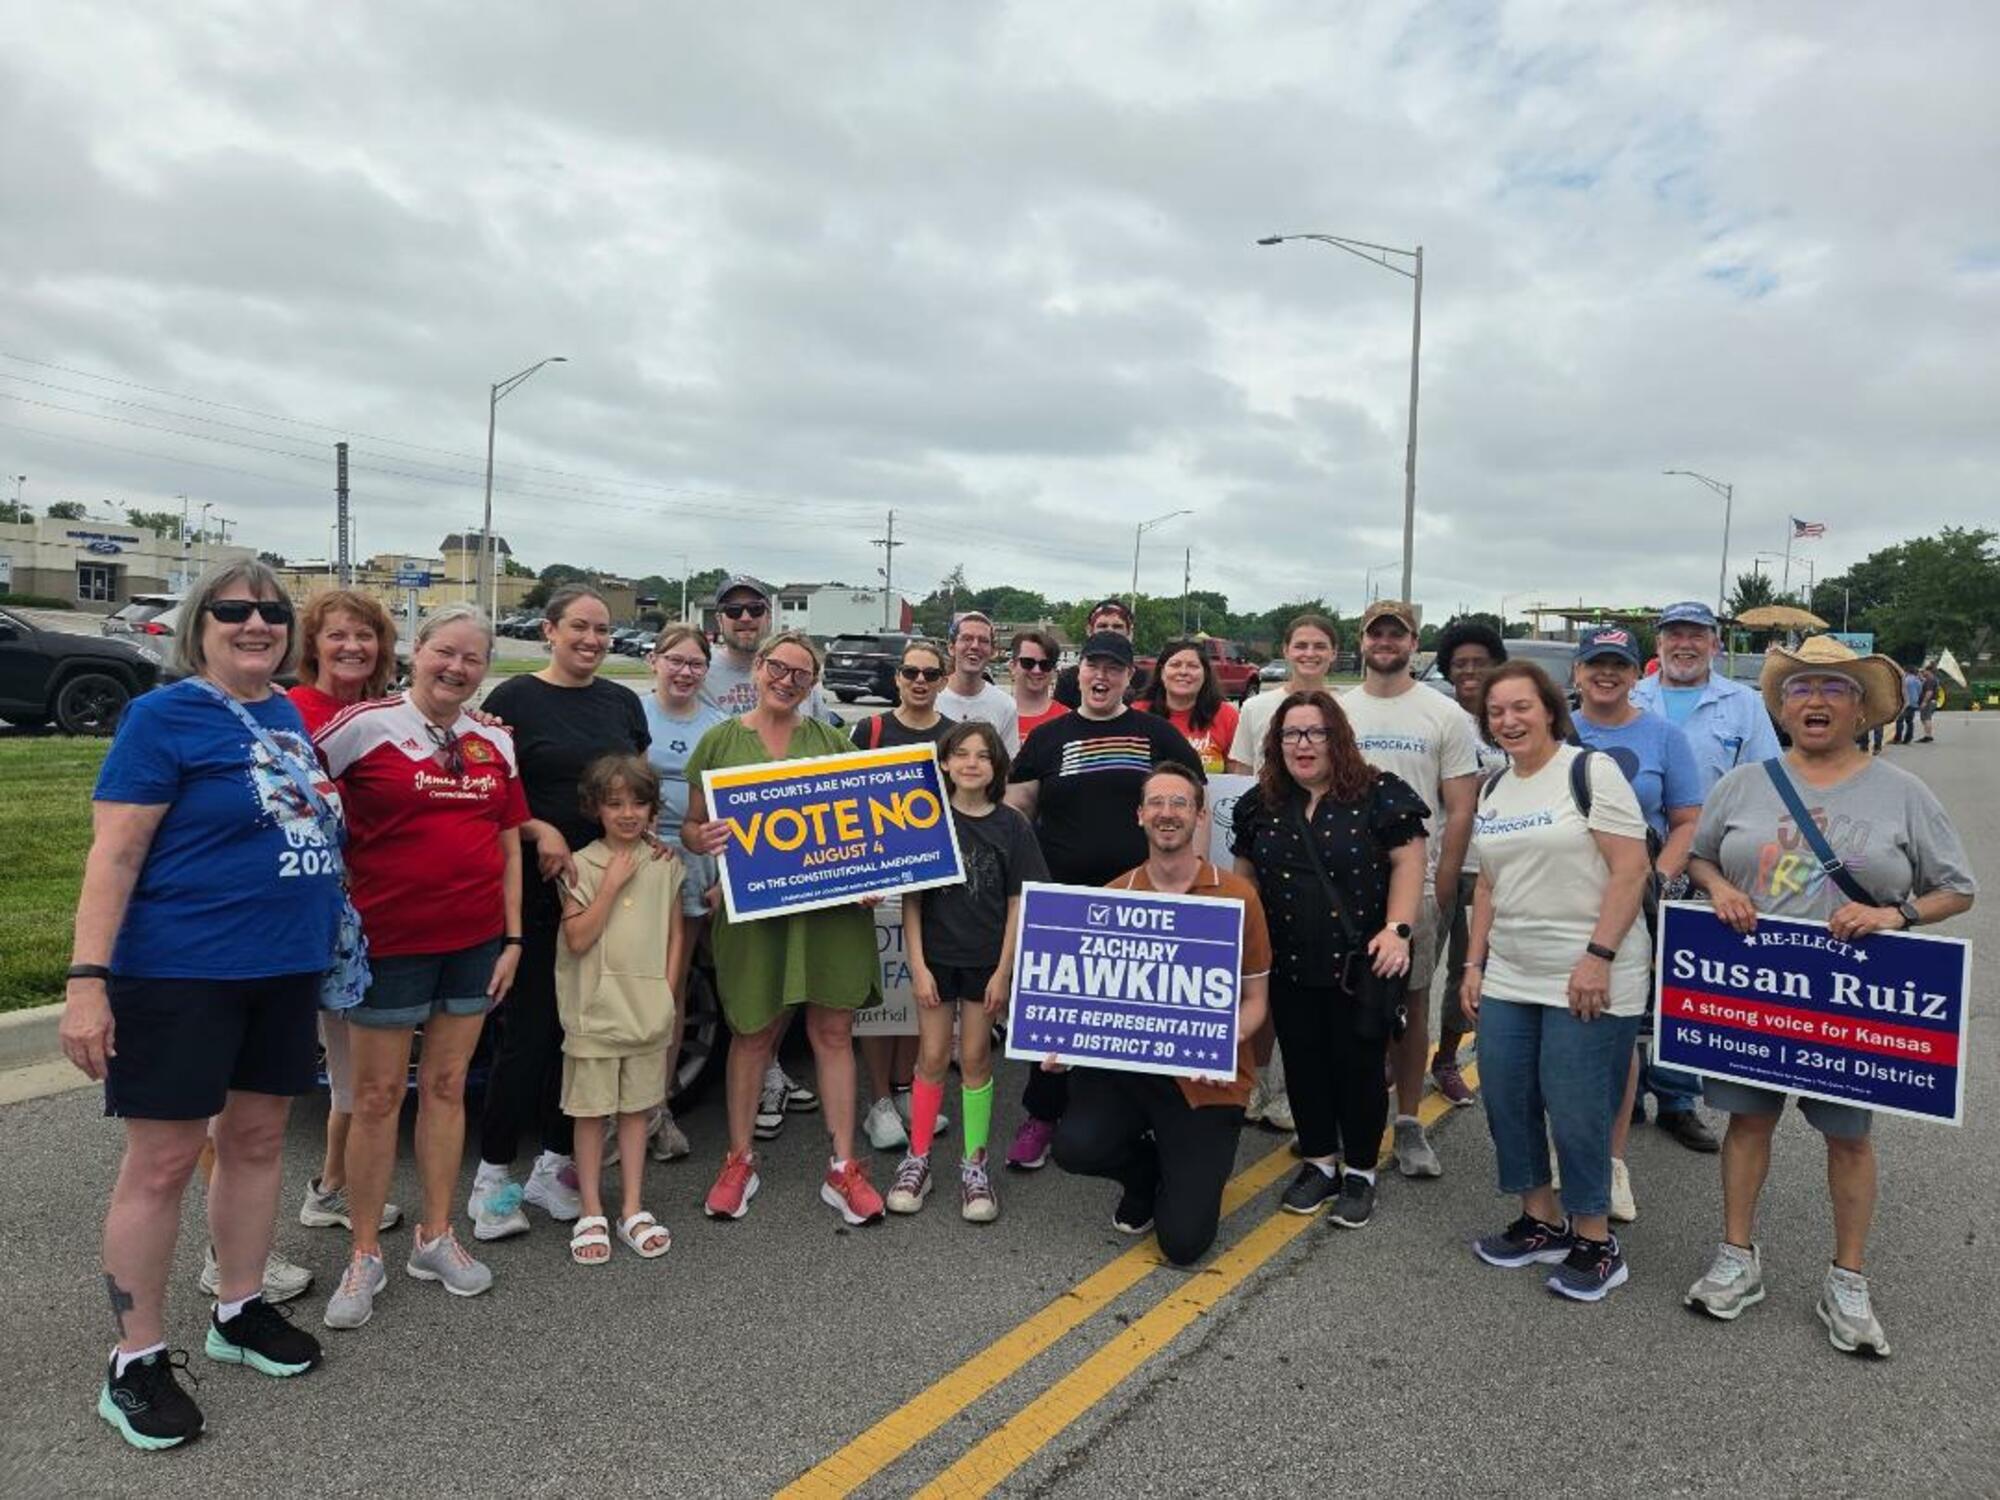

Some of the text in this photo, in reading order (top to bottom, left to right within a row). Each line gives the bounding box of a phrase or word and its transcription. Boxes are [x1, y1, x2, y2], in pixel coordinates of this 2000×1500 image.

[729, 768, 924, 805] OUR COURTS ARE NOT FOR SALE
[285, 825, 329, 849] US
[724, 788, 941, 856] VOTE NO
[279, 850, 337, 877] 202
[803, 840, 884, 867] AUGUST 4
[747, 881, 765, 892] ON
[768, 877, 787, 889] THE
[789, 862, 877, 886] CONSTITUTIONAL
[880, 850, 940, 870] AMENDMENT
[1116, 906, 1175, 930] VOTE
[1079, 936, 1179, 962] ZACHARY
[1760, 932, 1851, 957] RE-ELECT
[1021, 951, 1234, 1008] HAWKINS
[1672, 949, 1947, 1020] Susan Ruiz
[1026, 1005, 1228, 1039] STATE REPRESENTATIVE
[1681, 998, 1931, 1054] A strong voice for Kansas
[1072, 1033, 1174, 1057] DISTRICT 30
[1676, 1027, 1702, 1045] KS
[1708, 1033, 1770, 1058] House
[1796, 1050, 1846, 1073] 23rd
[1855, 1060, 1935, 1090] District
